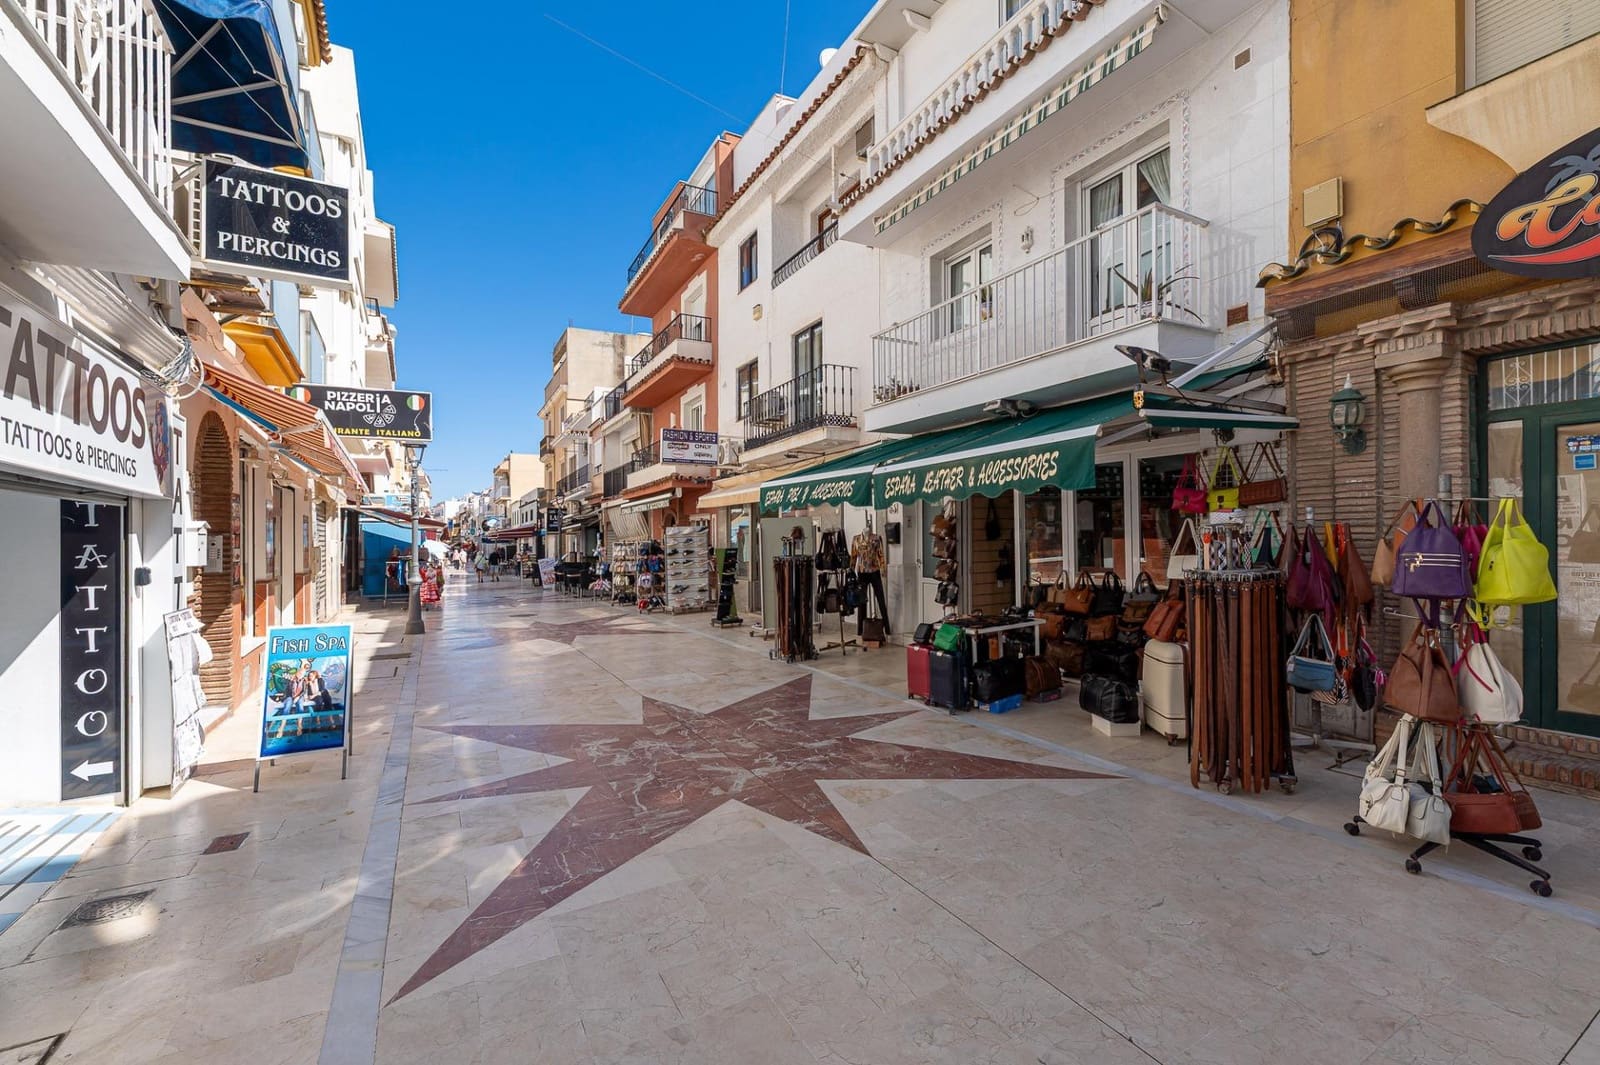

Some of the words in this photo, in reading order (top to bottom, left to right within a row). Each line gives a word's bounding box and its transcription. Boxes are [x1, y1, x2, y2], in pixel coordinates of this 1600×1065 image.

[215, 175, 342, 219] TATTOOS
[272, 216, 291, 235] &
[217, 230, 341, 268] PIERCINGS
[1, 417, 72, 460] TATTOOS
[75, 441, 85, 464] &
[87, 445, 137, 478] PIERCINGS
[376, 430, 422, 438] ITALIANO
[663, 429, 689, 441] FASHION
[694, 432, 717, 443] SPORTS
[884, 470, 916, 499] ESPAÑA
[922, 465, 964, 494] LEATHER
[968, 466, 975, 488] &
[977, 450, 1060, 487] ACCESSORIES
[74, 501, 108, 737] TATTOO
